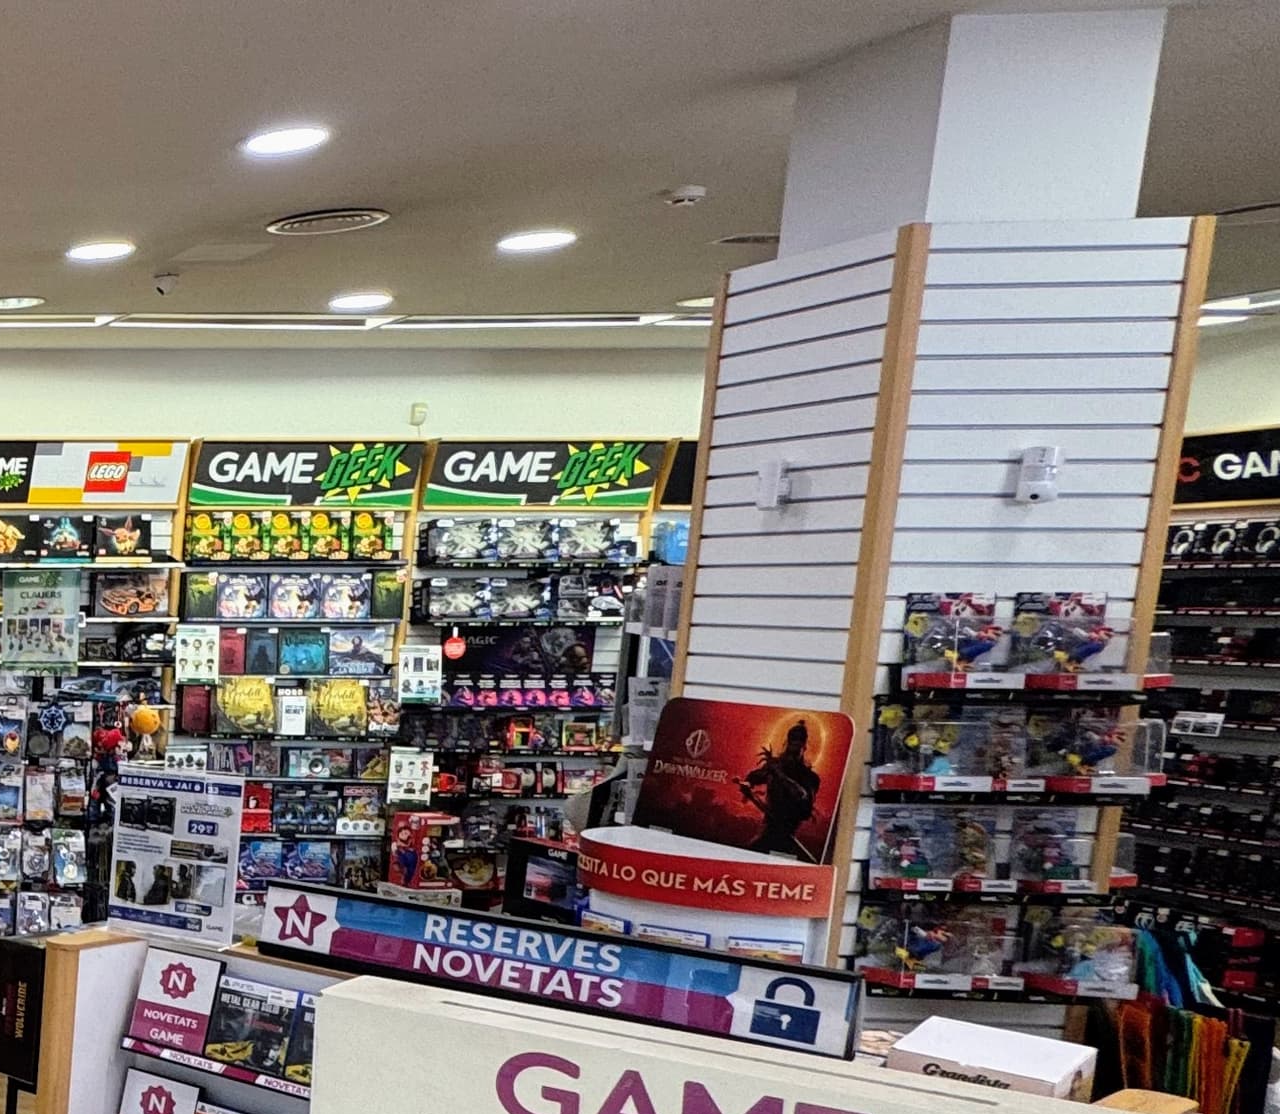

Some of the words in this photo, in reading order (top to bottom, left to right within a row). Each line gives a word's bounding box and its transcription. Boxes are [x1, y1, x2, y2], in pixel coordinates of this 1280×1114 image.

[87, 462, 127, 481] LEGO
[208, 451, 319, 483] GAME
[321, 444, 407, 490] GEEK
[444, 451, 556, 483] GAME
[558, 444, 644, 488] GEEK
[654, 759, 728, 783] DAWNWALKER
[612, 863, 637, 881] LO
[641, 869, 687, 890] QUE
[693, 873, 746, 896] MÁS
[753, 881, 815, 901] TEME
[424, 914, 622, 974] RESERVES
[413, 945, 624, 1008] NOVETATS
[143, 1008, 198, 1029] NOVETATS
[149, 1028, 184, 1046] GAME
[169, 1051, 214, 1070] NOVETATS
[922, 1062, 1011, 1090] Grandista
